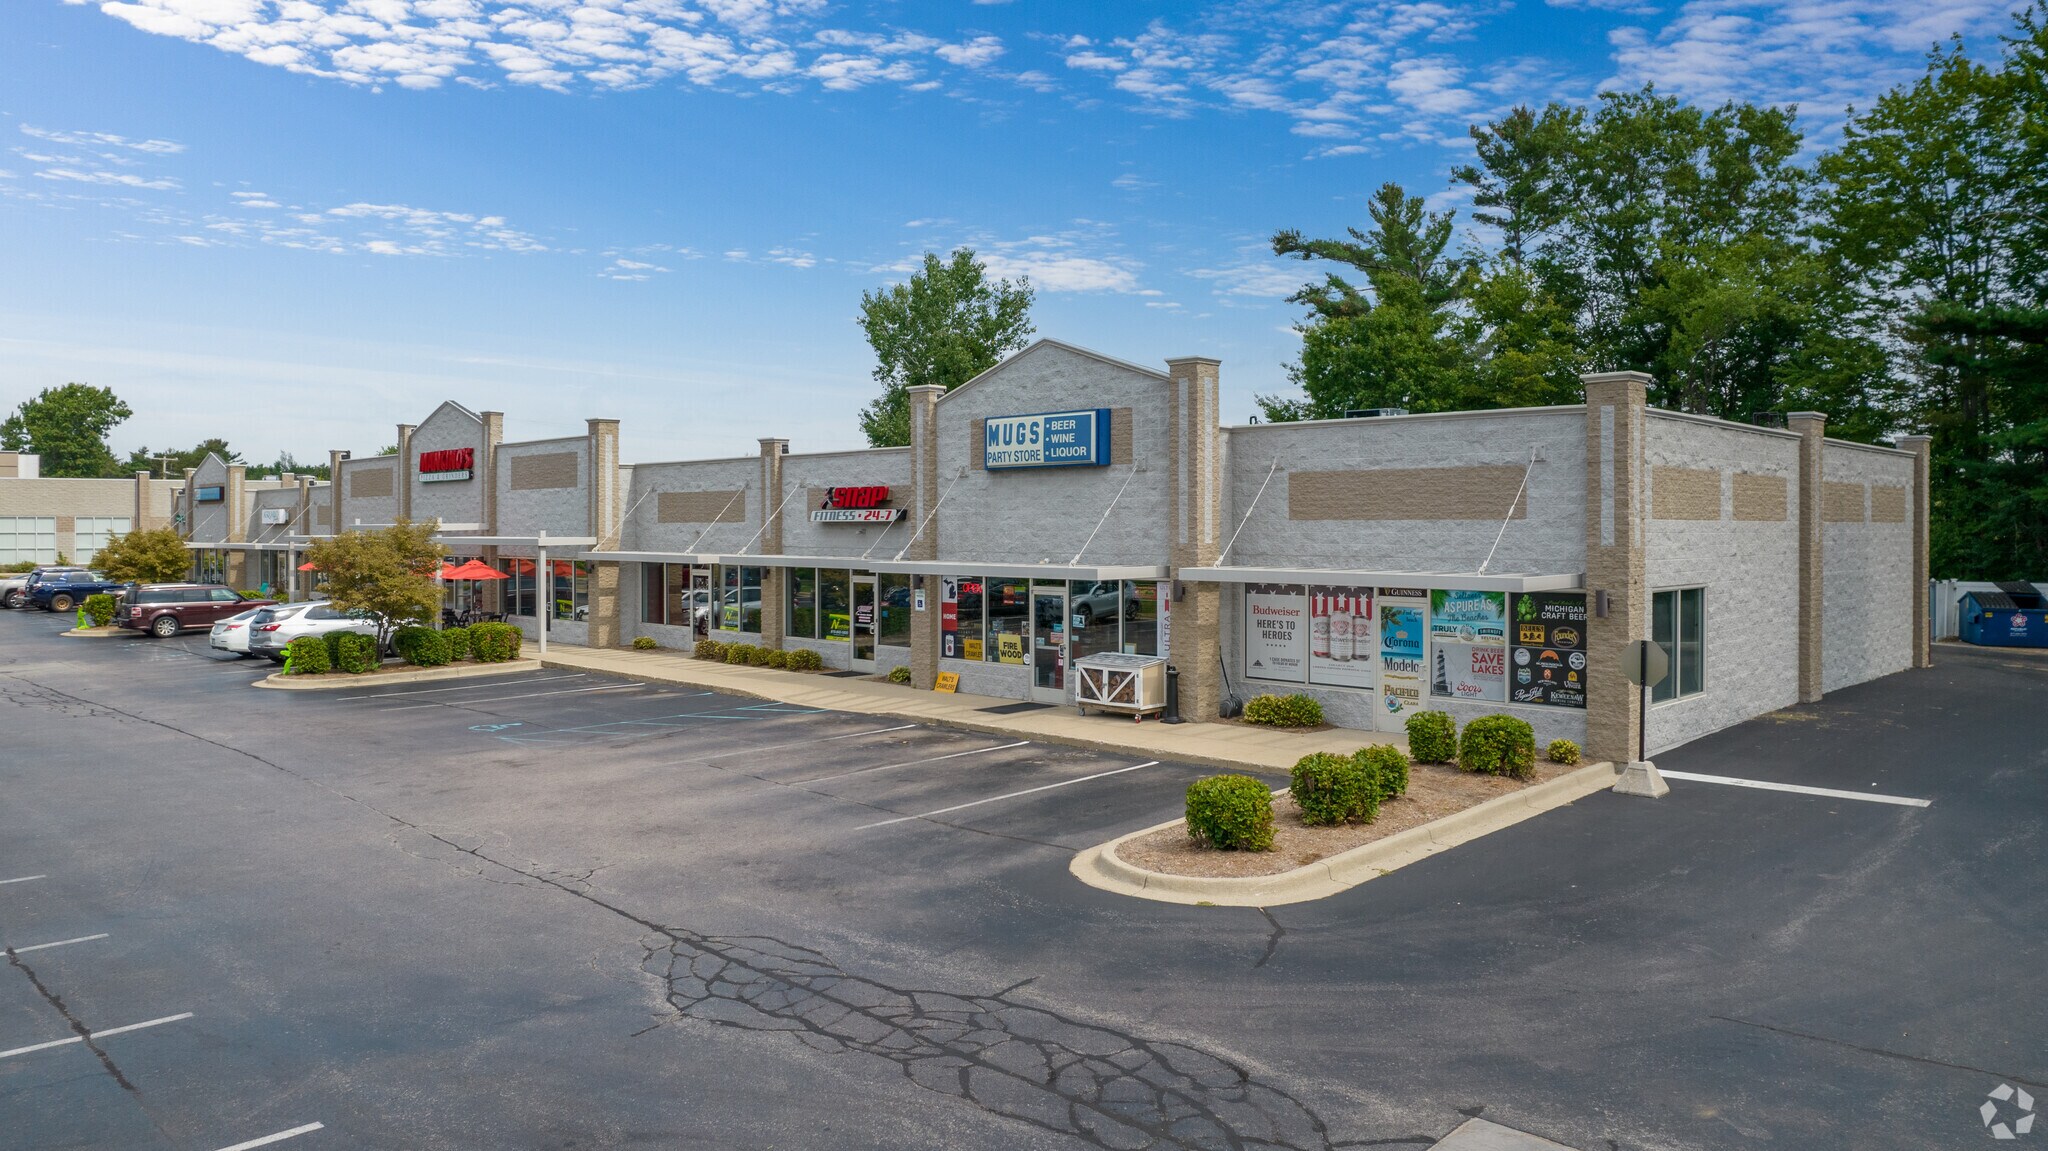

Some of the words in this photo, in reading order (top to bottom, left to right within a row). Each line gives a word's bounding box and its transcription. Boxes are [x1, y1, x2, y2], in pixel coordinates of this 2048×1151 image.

[1051, 420, 1076, 431] BEER
[988, 421, 1040, 447] MUGS
[1051, 433, 1076, 443] WINE
[987, 451, 1013, 463] PARTY
[1014, 450, 1041, 462] STORE
[1051, 446, 1087, 457] LIQUOR
[814, 511, 856, 521] FITNESS
[864, 510, 892, 521] 24-7
[962, 582, 983, 594] OPEN
[1391, 588, 1423, 597] GUINNESS
[1252, 604, 1300, 616] Budweiser
[1444, 602, 1455, 613] AS
[1456, 600, 1480, 613] PURE
[1481, 599, 1493, 611] AS
[1544, 605, 1585, 613] MICHIGAN
[1461, 612, 1489, 621] Beaches
[1541, 611, 1566, 620] CRAFT
[1568, 613, 1588, 621] BEER
[1257, 619, 1284, 630] HERE'S
[1286, 621, 1296, 630] TO
[1433, 625, 1458, 633] TRULY
[1262, 630, 1293, 641] HEROES
[1003, 641, 1018, 650] FIRE
[1384, 636, 1420, 649] Corona
[1000, 649, 1022, 659] WOOD
[1472, 652, 1504, 666] SAVE
[1384, 656, 1420, 673] Modelo
[1471, 663, 1504, 676] LAKES
[1456, 680, 1482, 693] Coors
